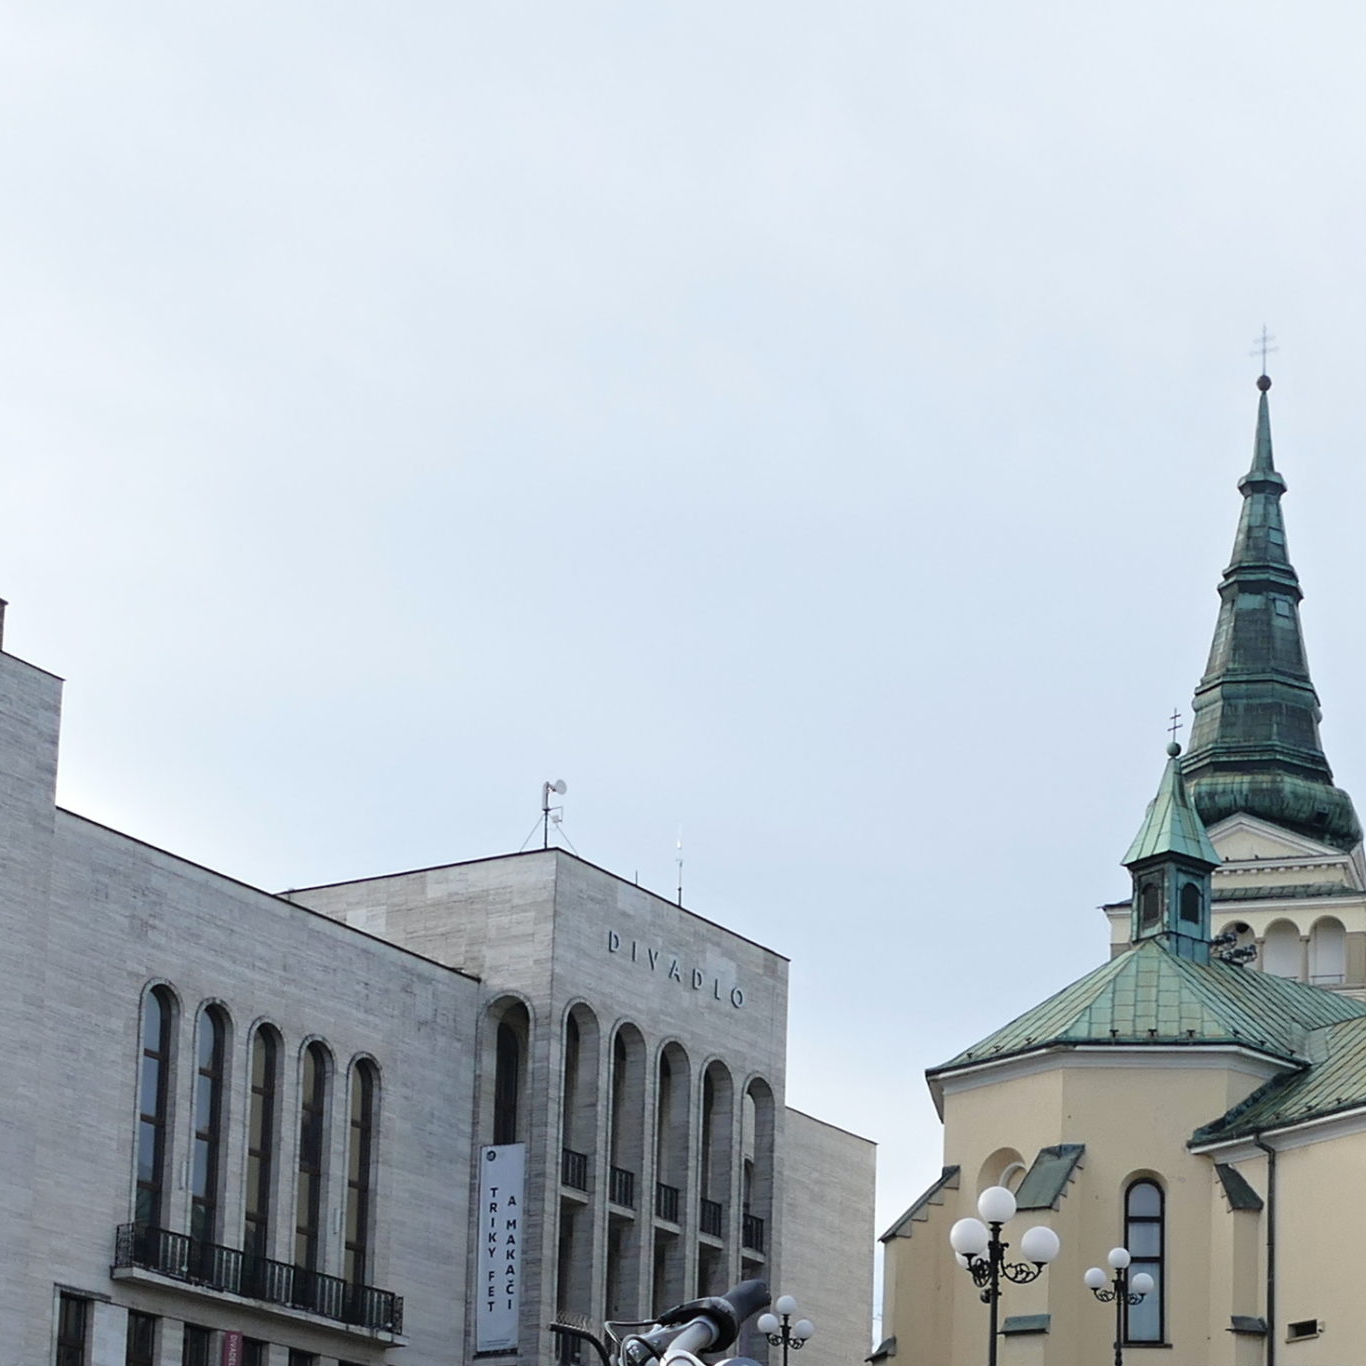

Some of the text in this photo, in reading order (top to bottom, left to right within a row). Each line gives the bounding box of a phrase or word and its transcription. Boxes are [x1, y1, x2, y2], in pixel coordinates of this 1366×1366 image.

[608, 929, 745, 1009] DIVADLO
[487, 1187, 499, 1312] TRIKY FET
[505, 1195, 517, 1310] A MAKAČI
